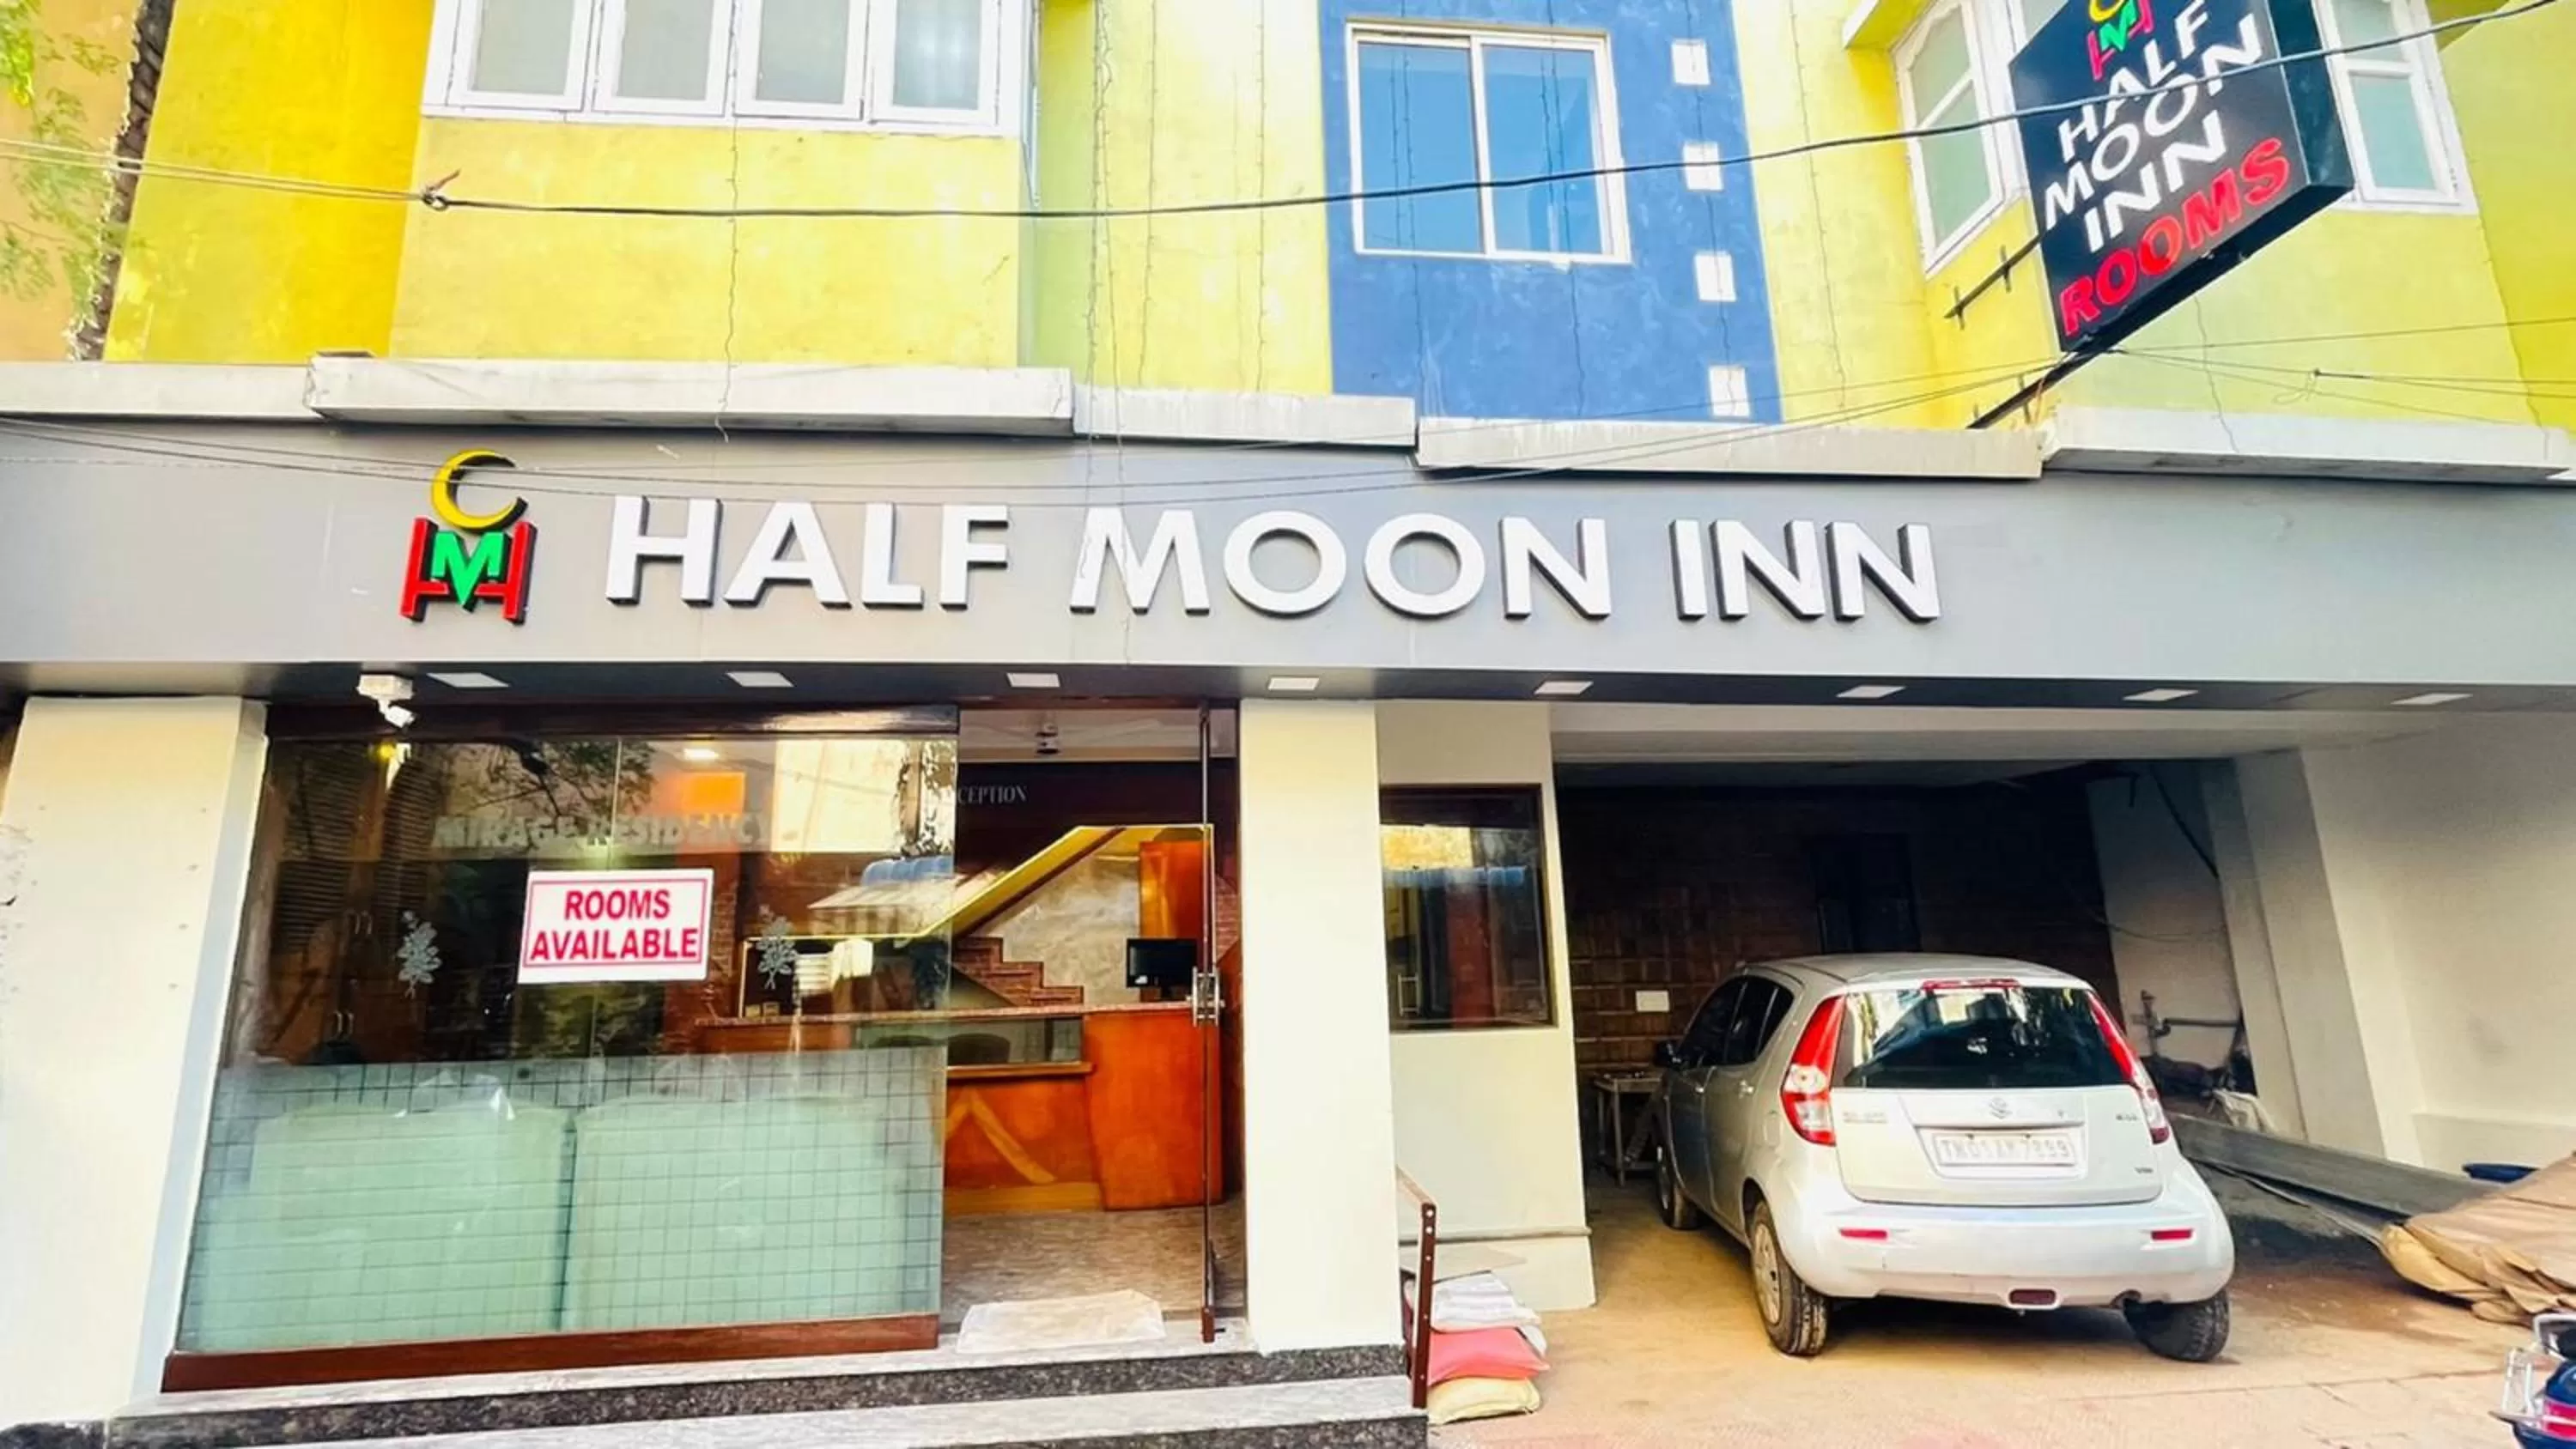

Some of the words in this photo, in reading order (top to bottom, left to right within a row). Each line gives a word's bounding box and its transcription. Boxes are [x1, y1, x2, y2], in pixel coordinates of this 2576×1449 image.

[2044, 13, 2263, 231] MOON
[2059, 0, 2208, 163] HALF
[2059, 136, 2290, 336] ROOMS
[2084, 109, 2227, 253] INN
[605, 495, 1009, 611] HALF
[1069, 506, 1612, 621] MOON
[1668, 518, 1941, 624] INN
[957, 785, 1028, 805] CEPTION
[530, 926, 699, 962] AVAILABLE
[564, 888, 671, 921] ROOMS
